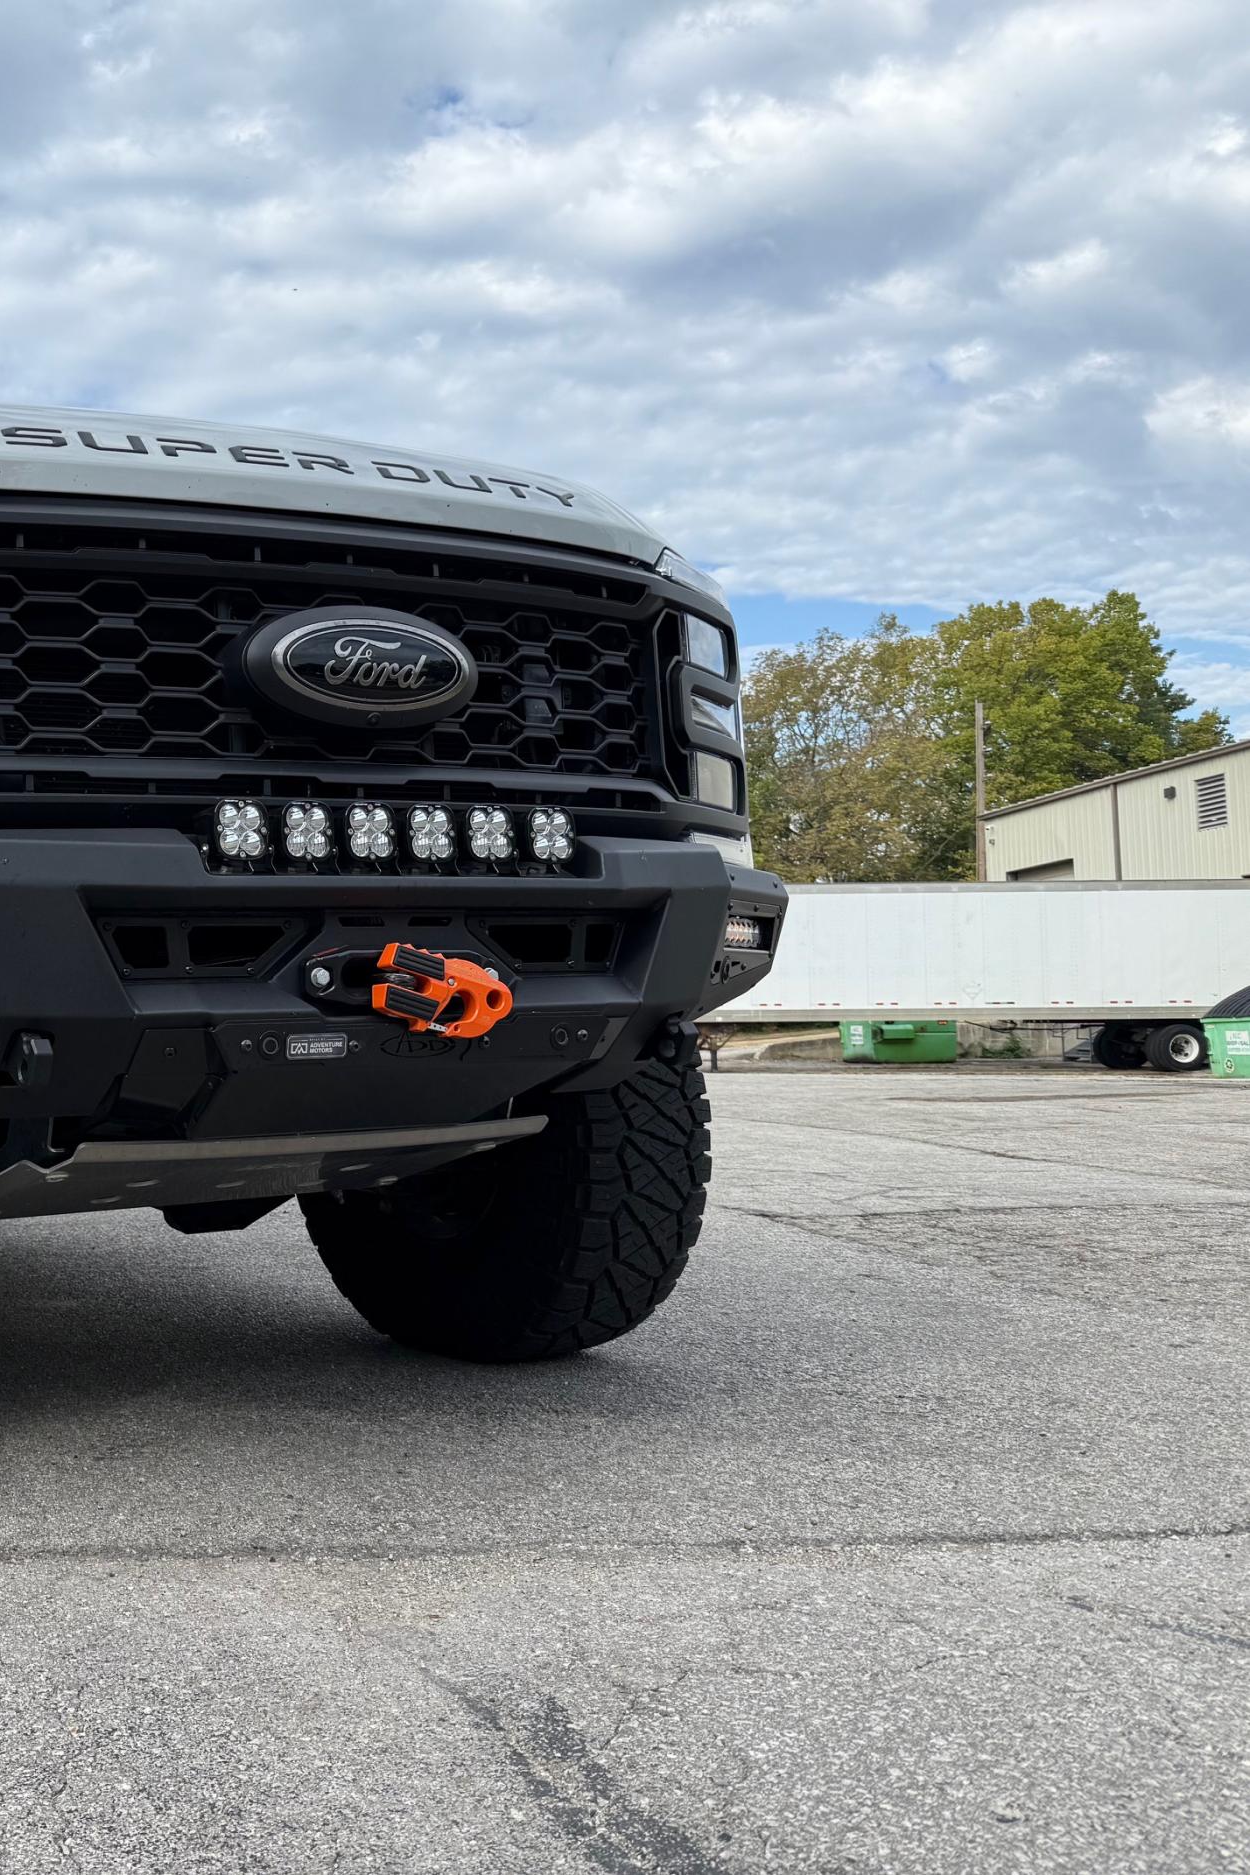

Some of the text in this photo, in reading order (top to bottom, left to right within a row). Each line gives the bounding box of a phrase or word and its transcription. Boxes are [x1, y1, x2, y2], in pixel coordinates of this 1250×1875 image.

[0, 426, 575, 508] SUPER DUTY
[324, 636, 428, 690] Ford
